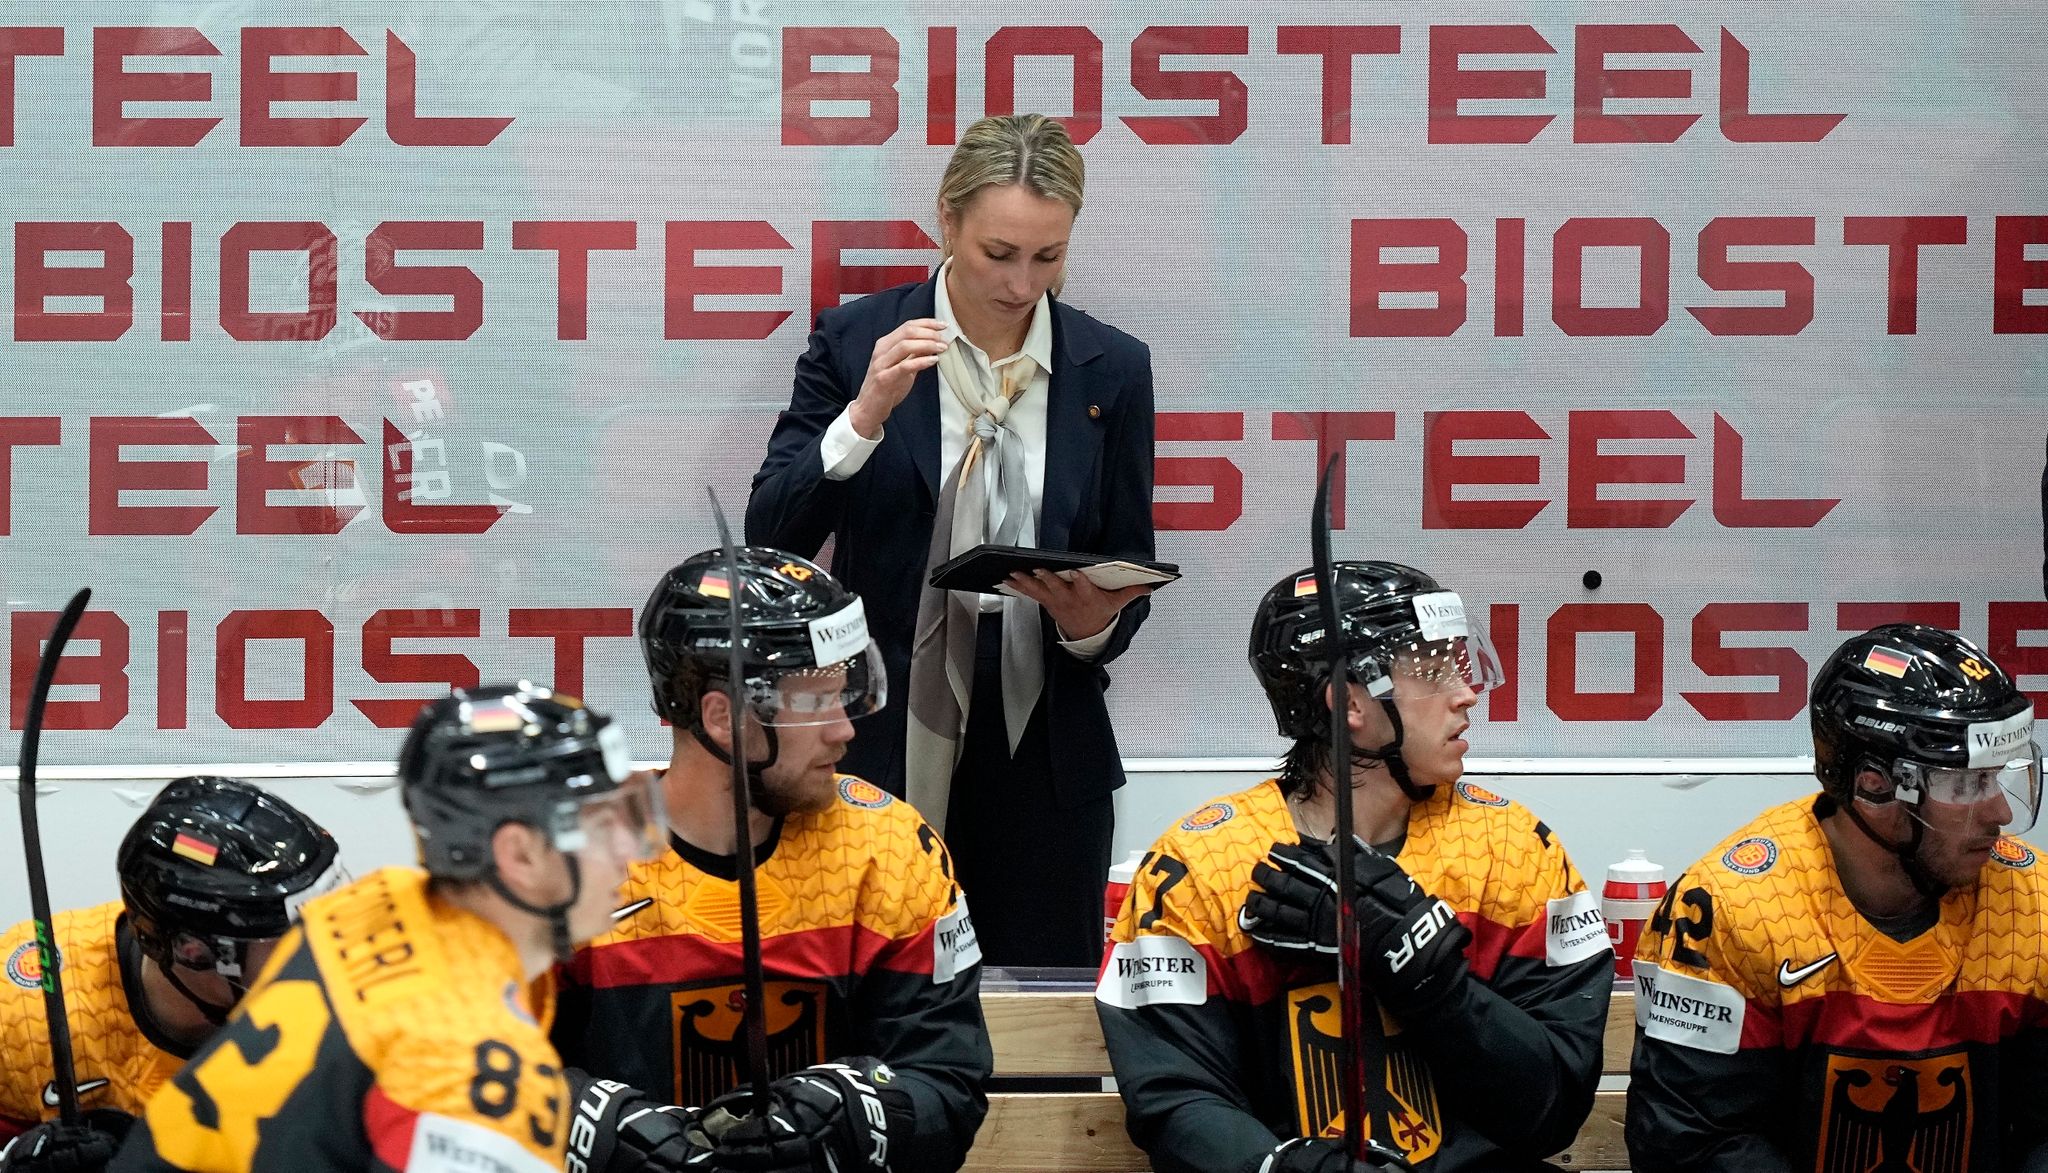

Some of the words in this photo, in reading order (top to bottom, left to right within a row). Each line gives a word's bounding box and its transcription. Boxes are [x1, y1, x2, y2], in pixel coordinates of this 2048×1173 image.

[781, 24, 1849, 146] BIOSTEEL
[1650, 873, 1714, 971] 42
[468, 1038, 560, 1148] 83
